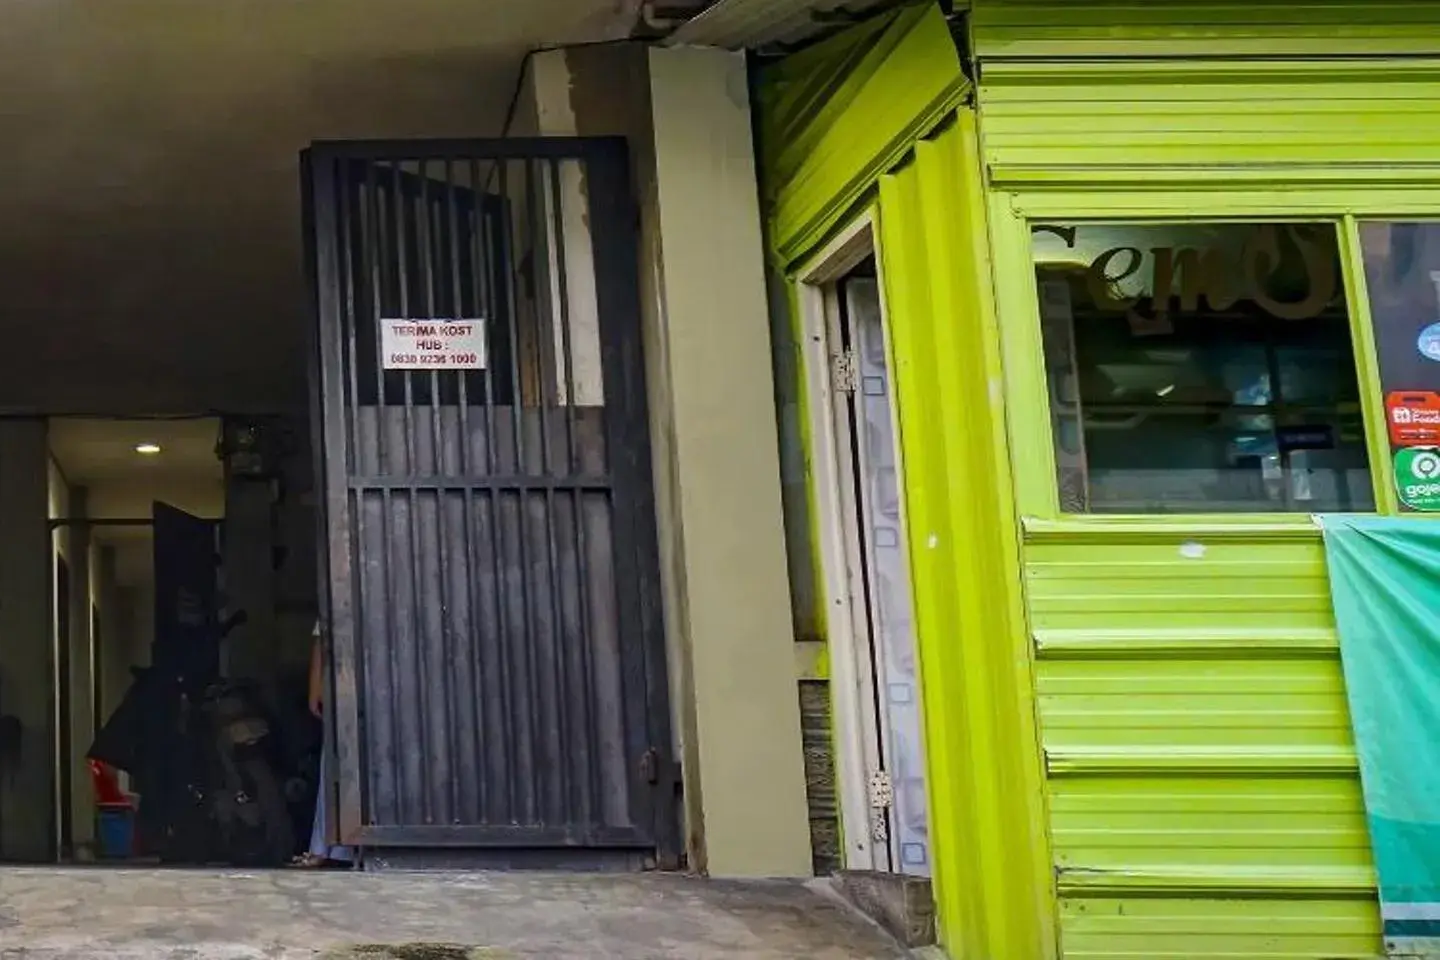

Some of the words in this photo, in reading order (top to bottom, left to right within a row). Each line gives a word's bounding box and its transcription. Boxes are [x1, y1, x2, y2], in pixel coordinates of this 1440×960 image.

[392, 325, 438, 337] TERIMA
[440, 325, 473, 337] KOST
[416, 339, 443, 350] HUB
